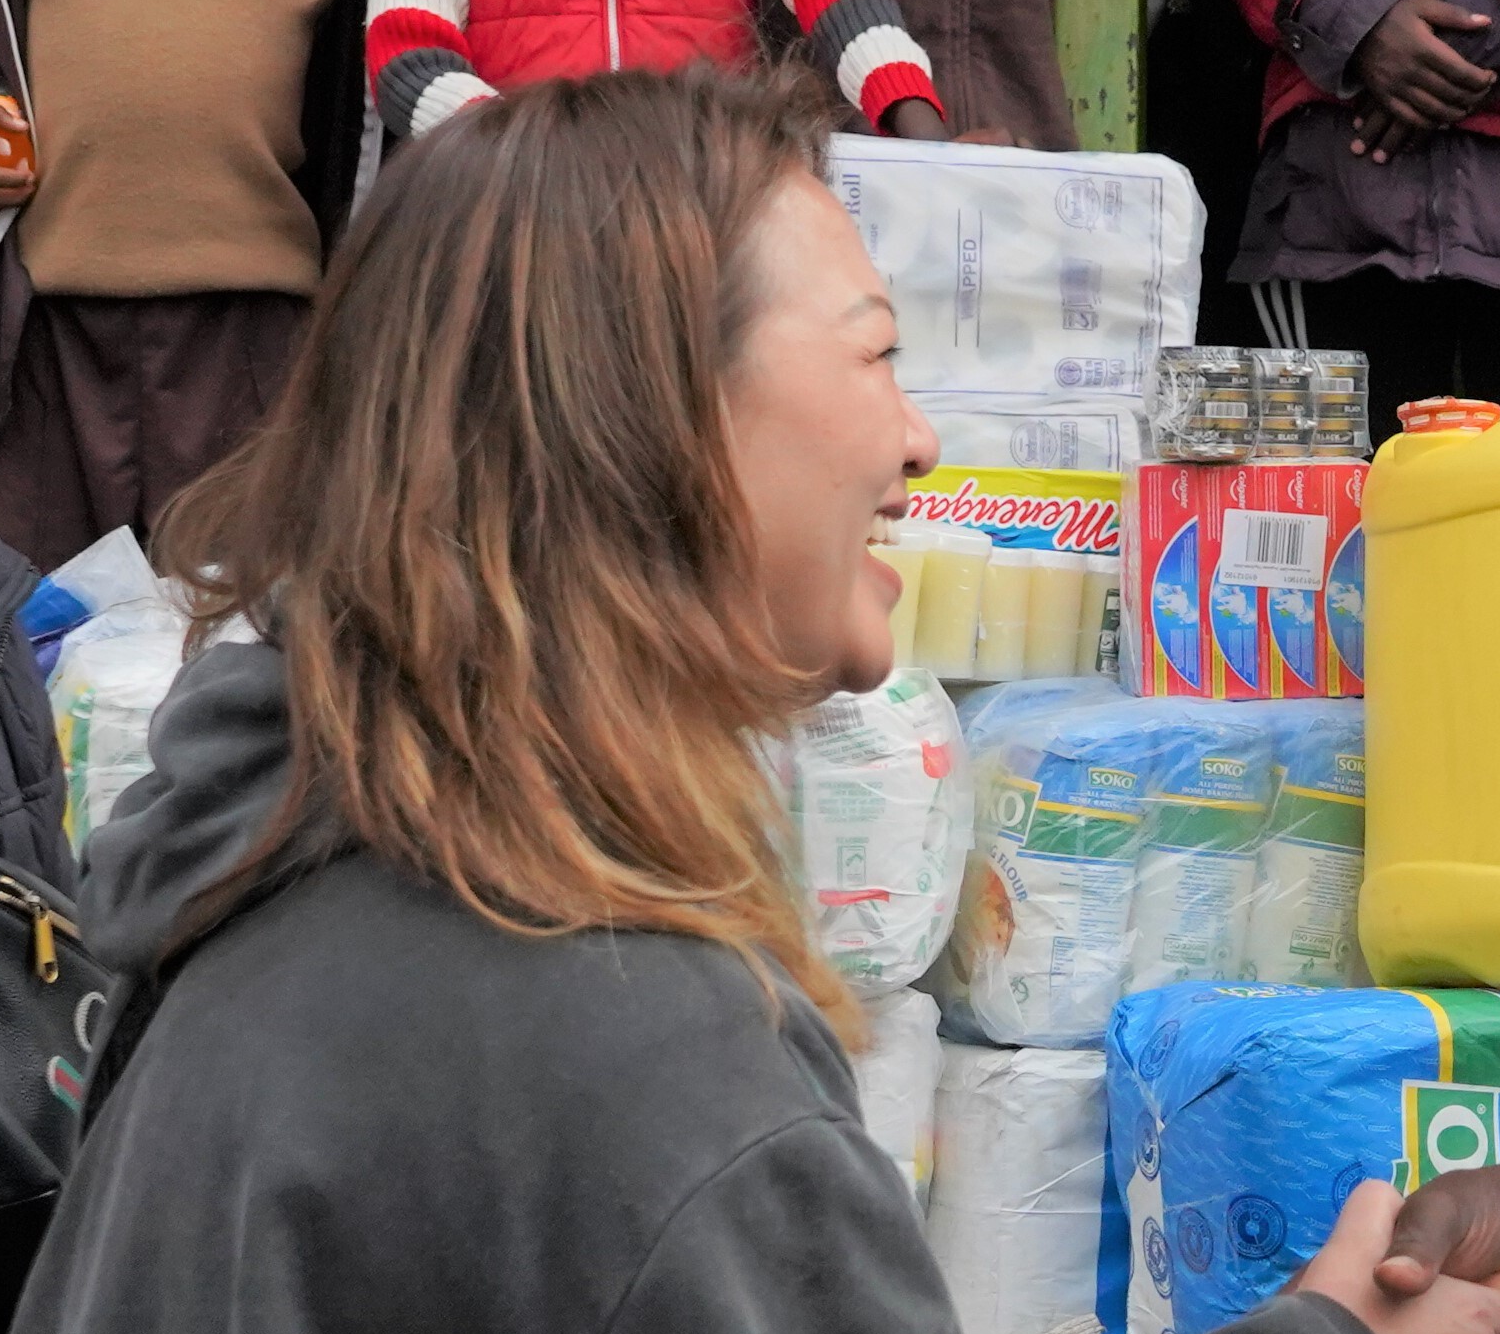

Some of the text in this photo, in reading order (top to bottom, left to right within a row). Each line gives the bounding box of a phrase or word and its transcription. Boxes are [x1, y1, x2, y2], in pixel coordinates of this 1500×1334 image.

[842, 173, 862, 217] Roll
[1180, 469, 1189, 509] Colgate
[1296, 470, 1305, 509] Colgate
[1092, 772, 1134, 790] SOKO
[1203, 763, 1244, 778] SOKO
[1338, 758, 1366, 773] SOK
[997, 854, 1028, 903] FLOUR
